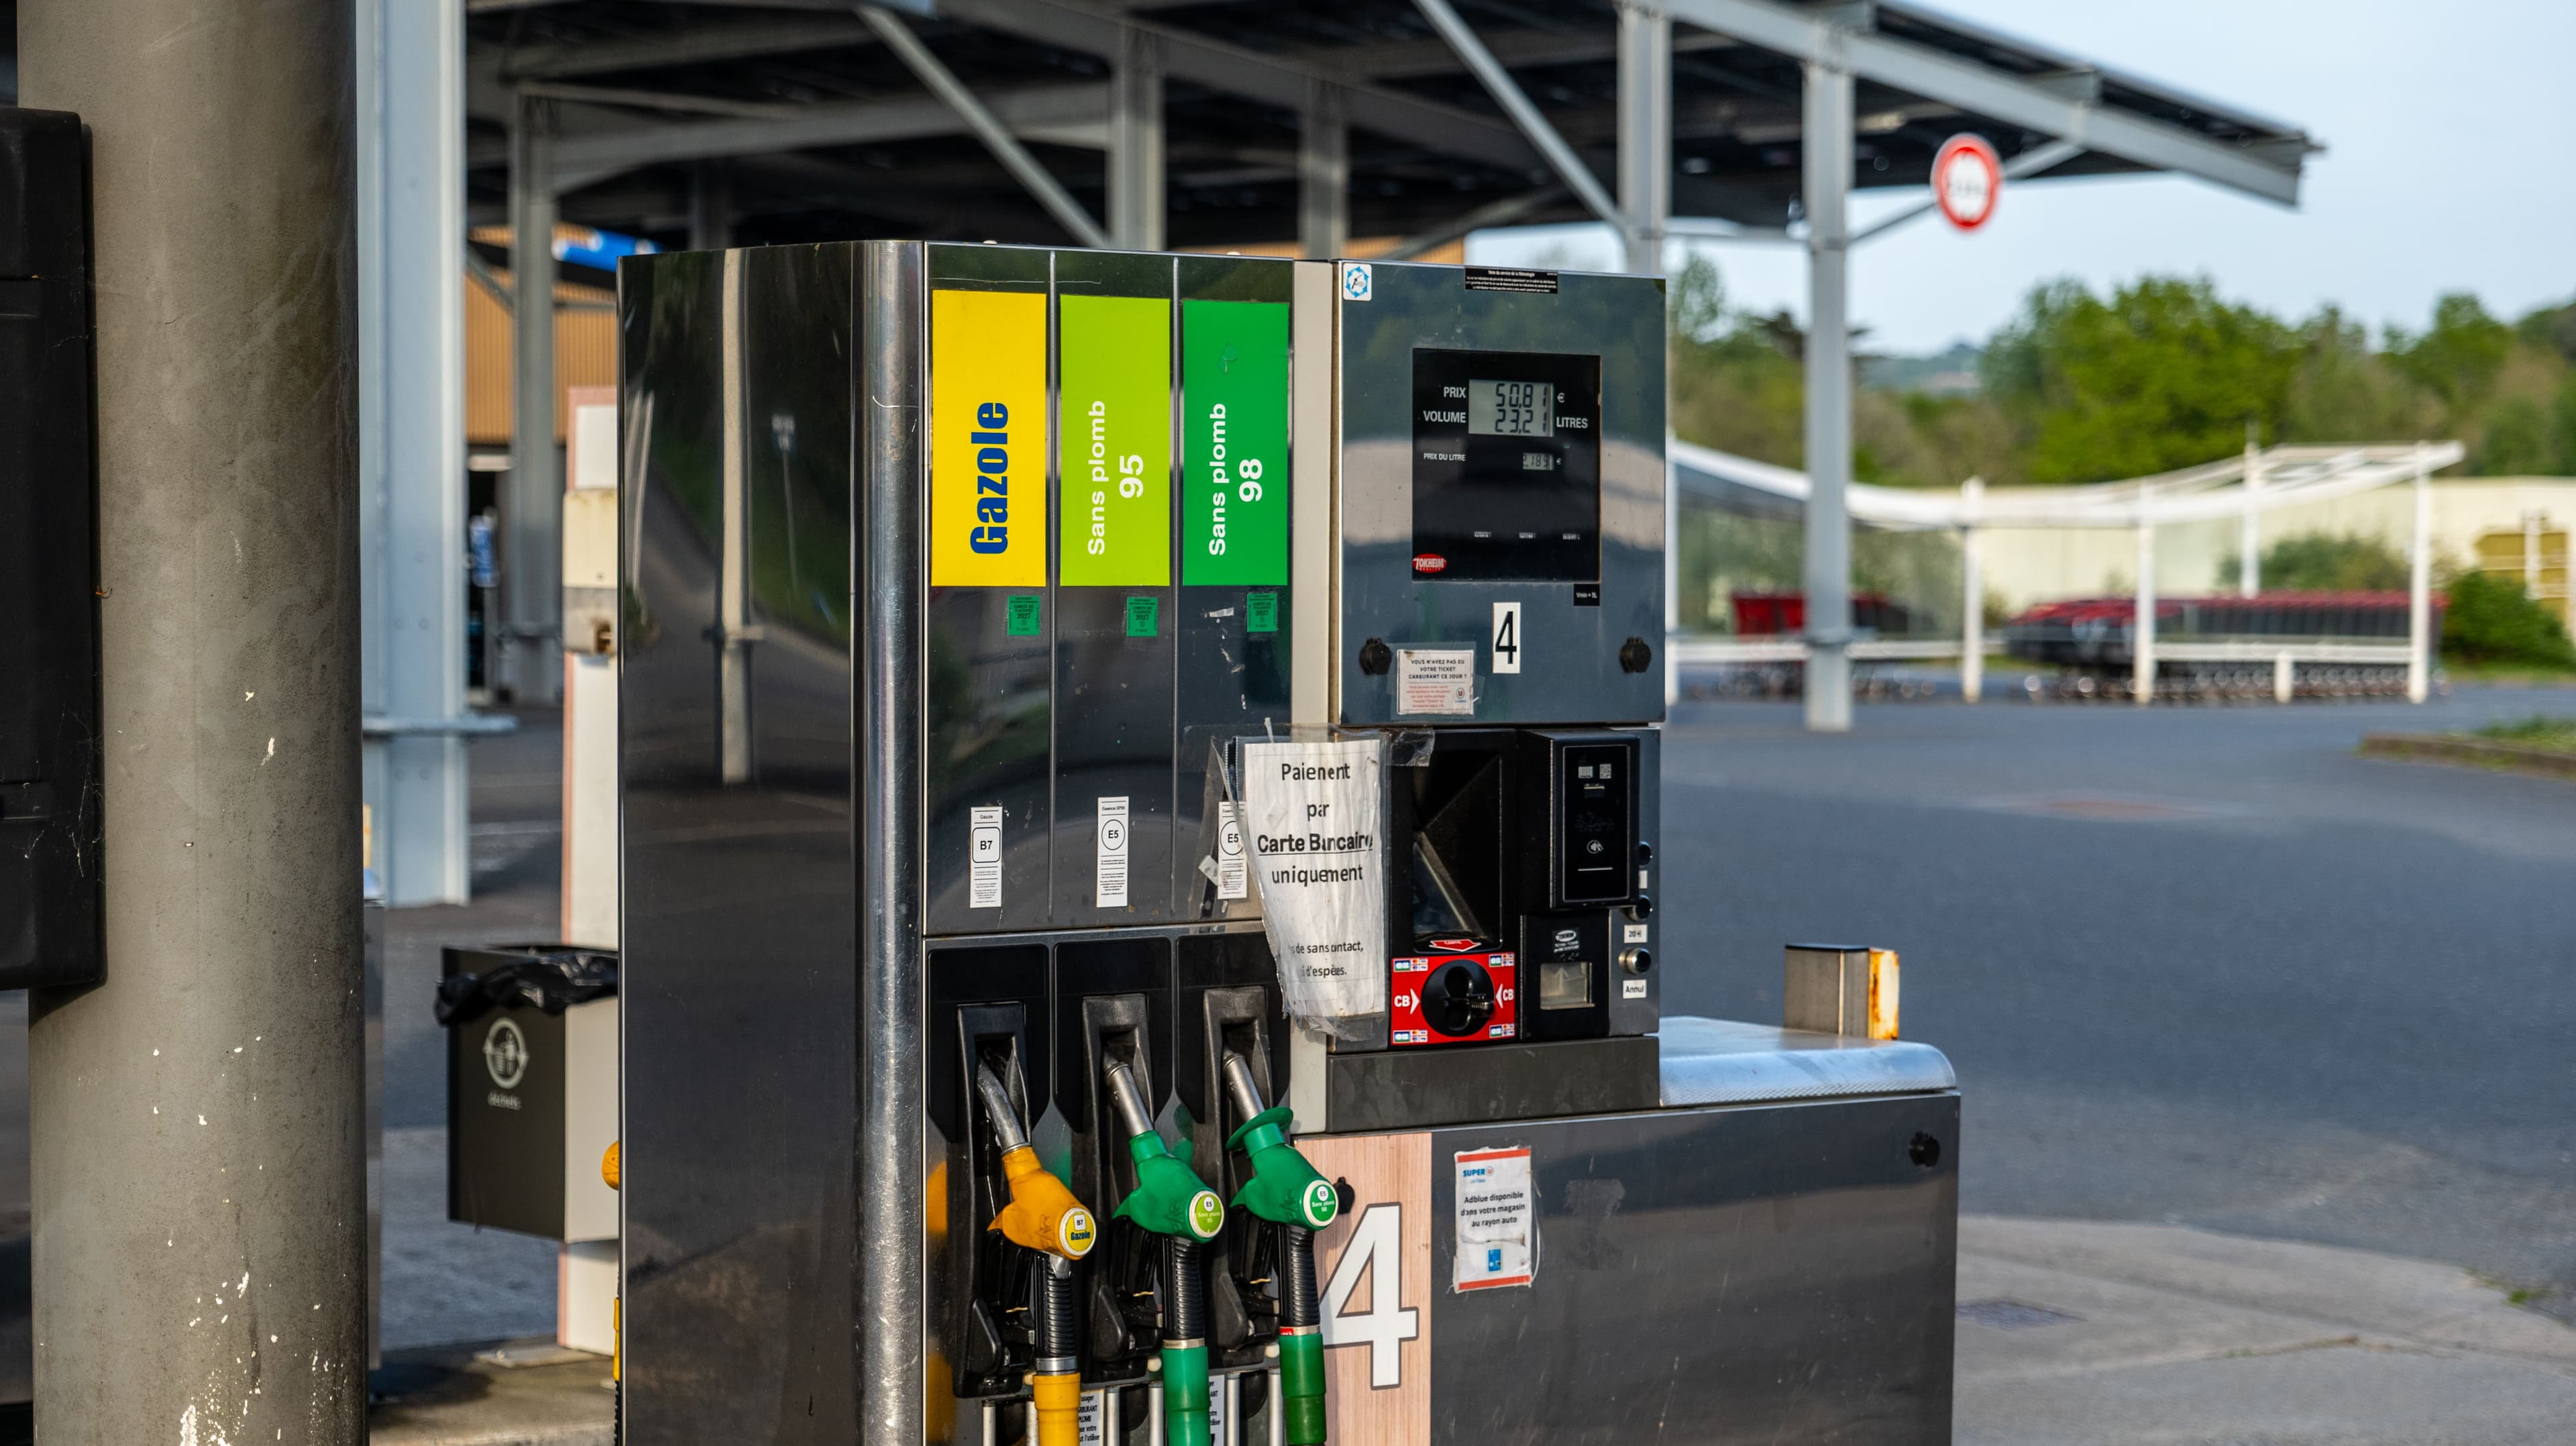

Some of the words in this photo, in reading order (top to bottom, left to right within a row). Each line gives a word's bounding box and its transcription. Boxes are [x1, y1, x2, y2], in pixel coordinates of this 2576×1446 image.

[1444, 387, 1466, 398] PRIX
[1495, 383, 1548, 408] 50,81
[1557, 392, 1565, 403] €
[1424, 410, 1466, 423] VOLUME
[1495, 408, 1548, 434] 23,21
[1556, 416, 1588, 429] LITRES
[1088, 401, 1109, 482] plomb
[1210, 403, 1230, 484] plomb
[1424, 453, 1437, 461] PRIX
[1449, 453, 1465, 461] LITRE
[970, 402, 1008, 555] Gazole
[1119, 455, 1144, 498] 95
[1239, 459, 1263, 502] 98
[1087, 491, 1106, 555] Sans
[1209, 492, 1226, 556] Sans
[1412, 558, 1442, 570] TOKHEIM
[1495, 611, 1517, 665] 4
[1108, 830, 1118, 838] E5
[1228, 834, 1239, 843] E5
[980, 840, 993, 850] B7
[1258, 834, 1305, 852] Carte
[1296, 943, 1305, 954] de
[1307, 944, 1330, 954] sans
[1394, 995, 1410, 1007] CB
[1503, 989, 1514, 1001] CB
[1462, 1168, 1485, 1177] SUPER
[1464, 1194, 1488, 1204] Adblue
[1489, 1191, 1523, 1202] disponible
[1460, 1209, 1477, 1217] dans
[1497, 1204, 1525, 1213] magasin
[1481, 1219, 1500, 1227] rayon
[1501, 1216, 1517, 1224] auto
[1071, 1230, 1091, 1241] Gazole
[1319, 1201, 1419, 1390] 4
